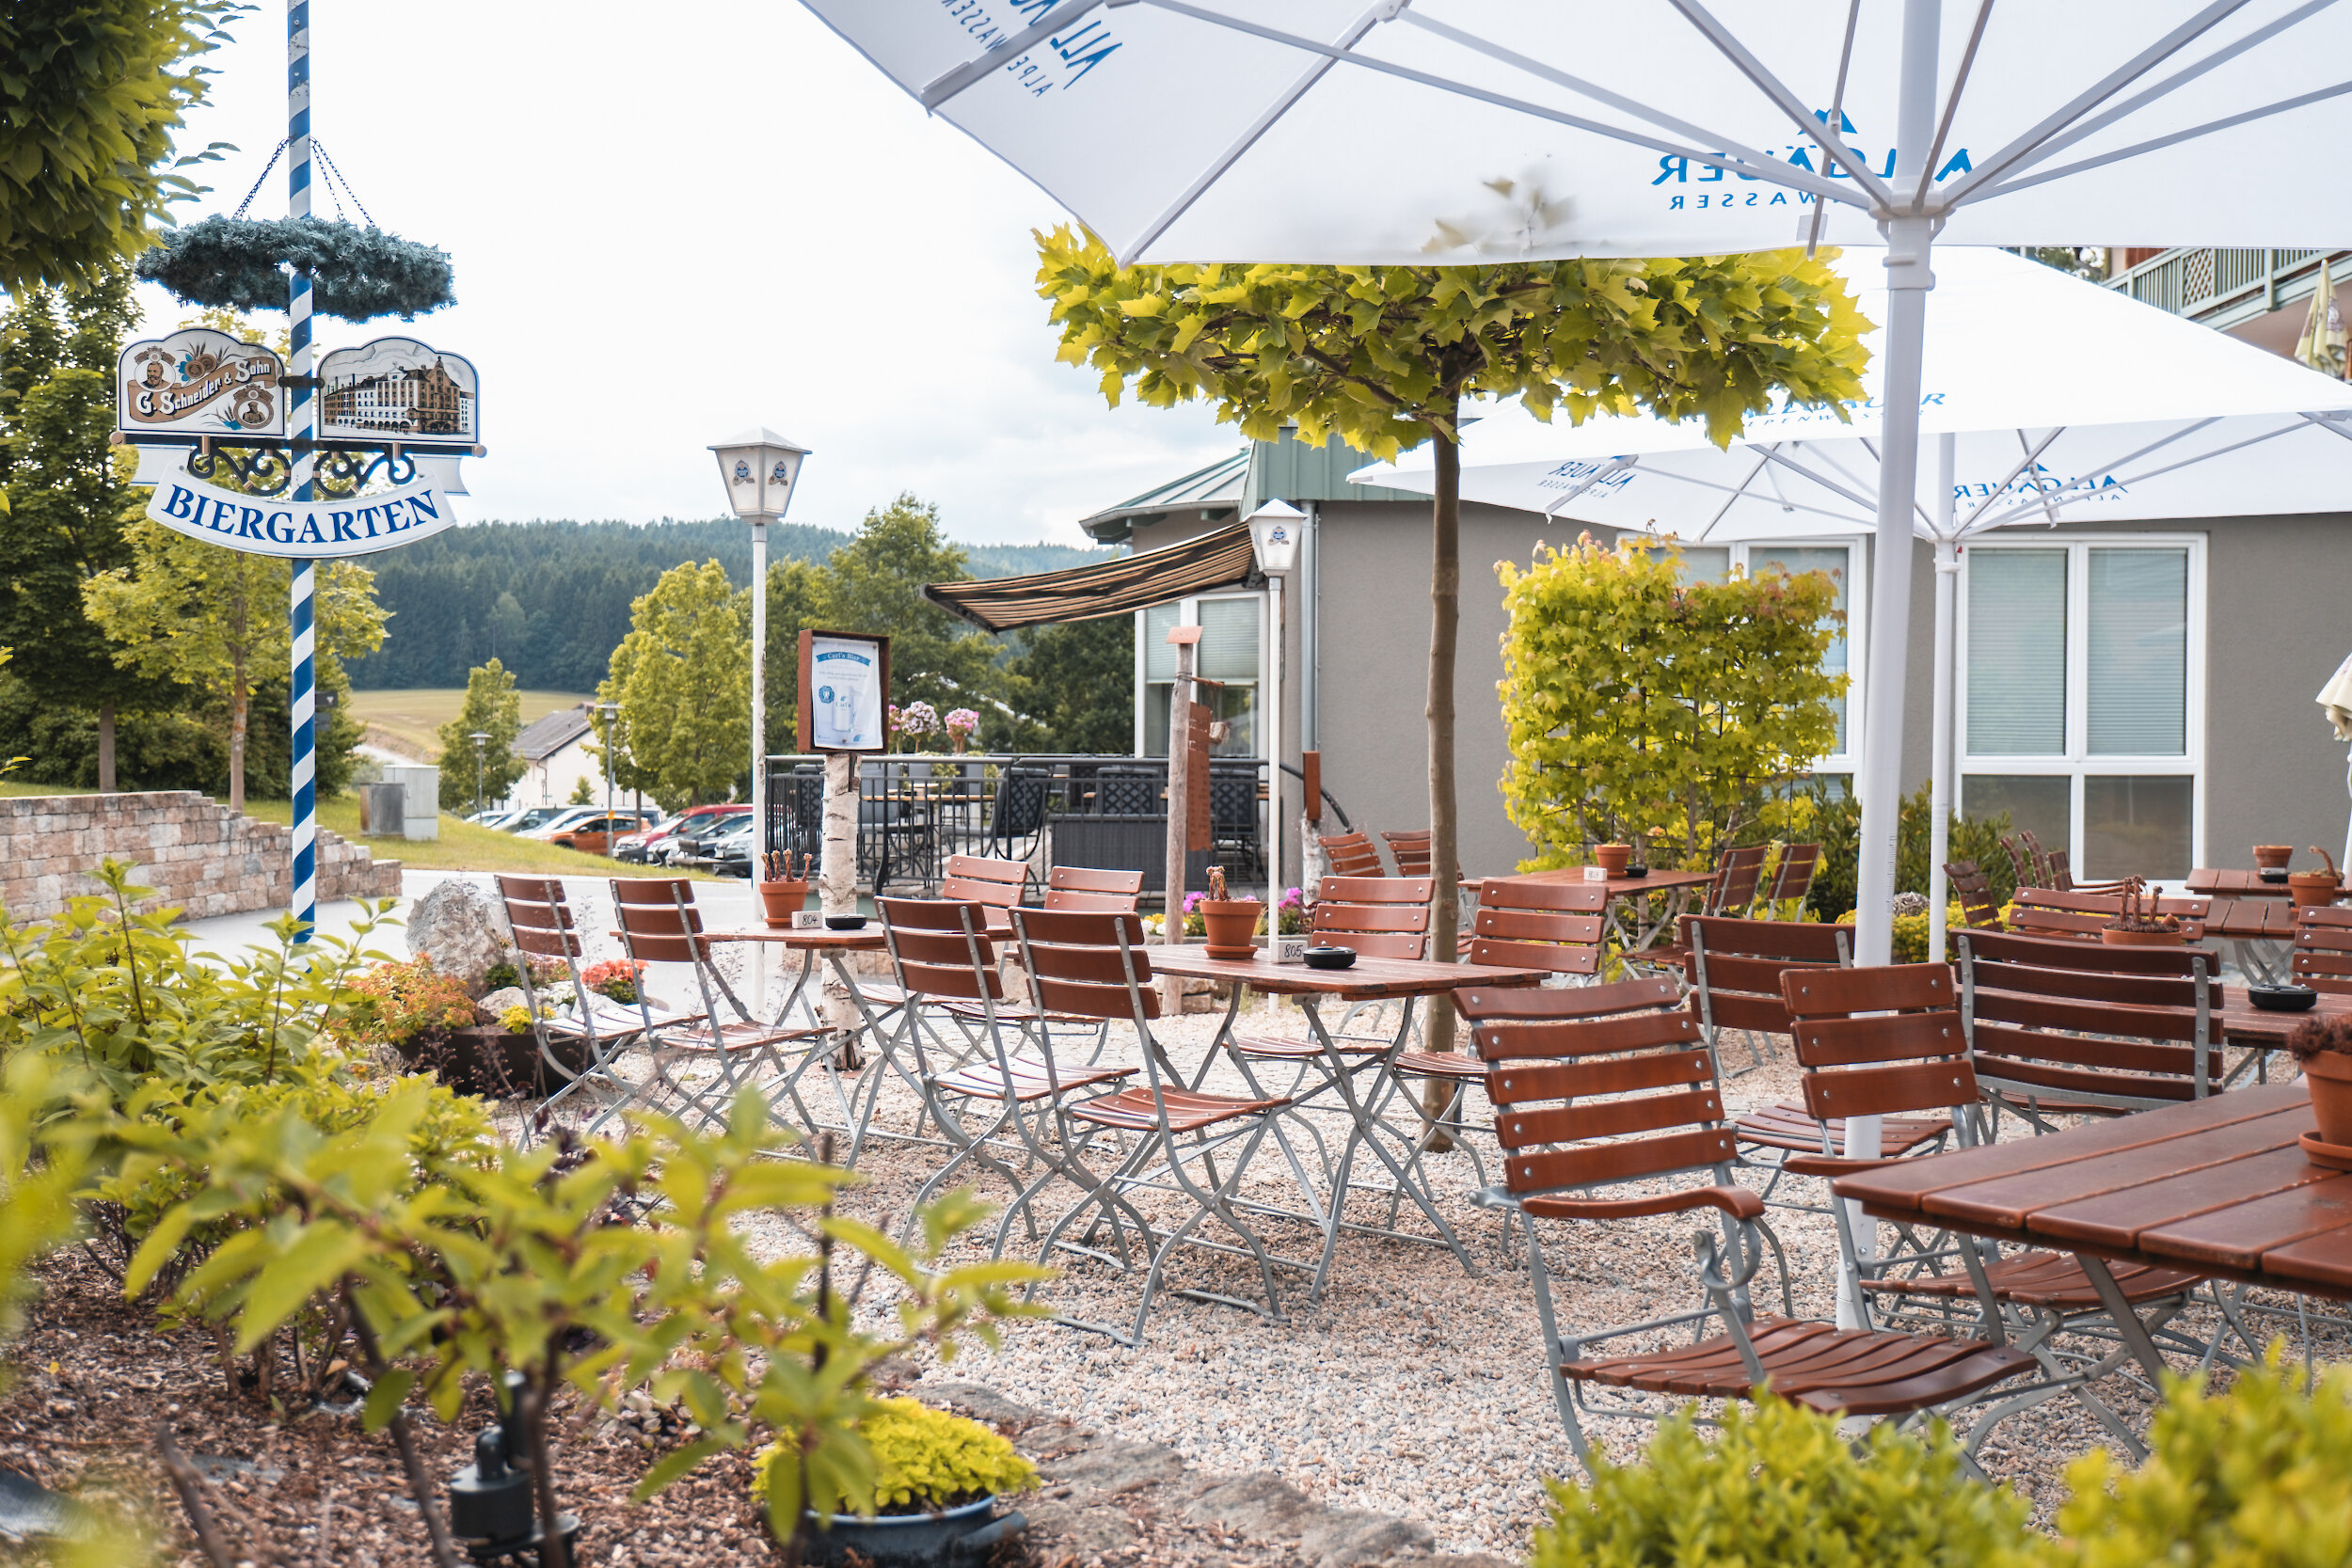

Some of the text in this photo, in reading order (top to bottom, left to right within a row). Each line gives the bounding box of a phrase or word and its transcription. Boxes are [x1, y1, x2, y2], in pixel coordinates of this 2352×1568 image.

[135, 359, 271, 416] G. Schneider & Sohn
[161, 483, 439, 543] BIERGARTEN
[803, 914, 818, 926] 804
[1283, 943, 1303, 958] 805
